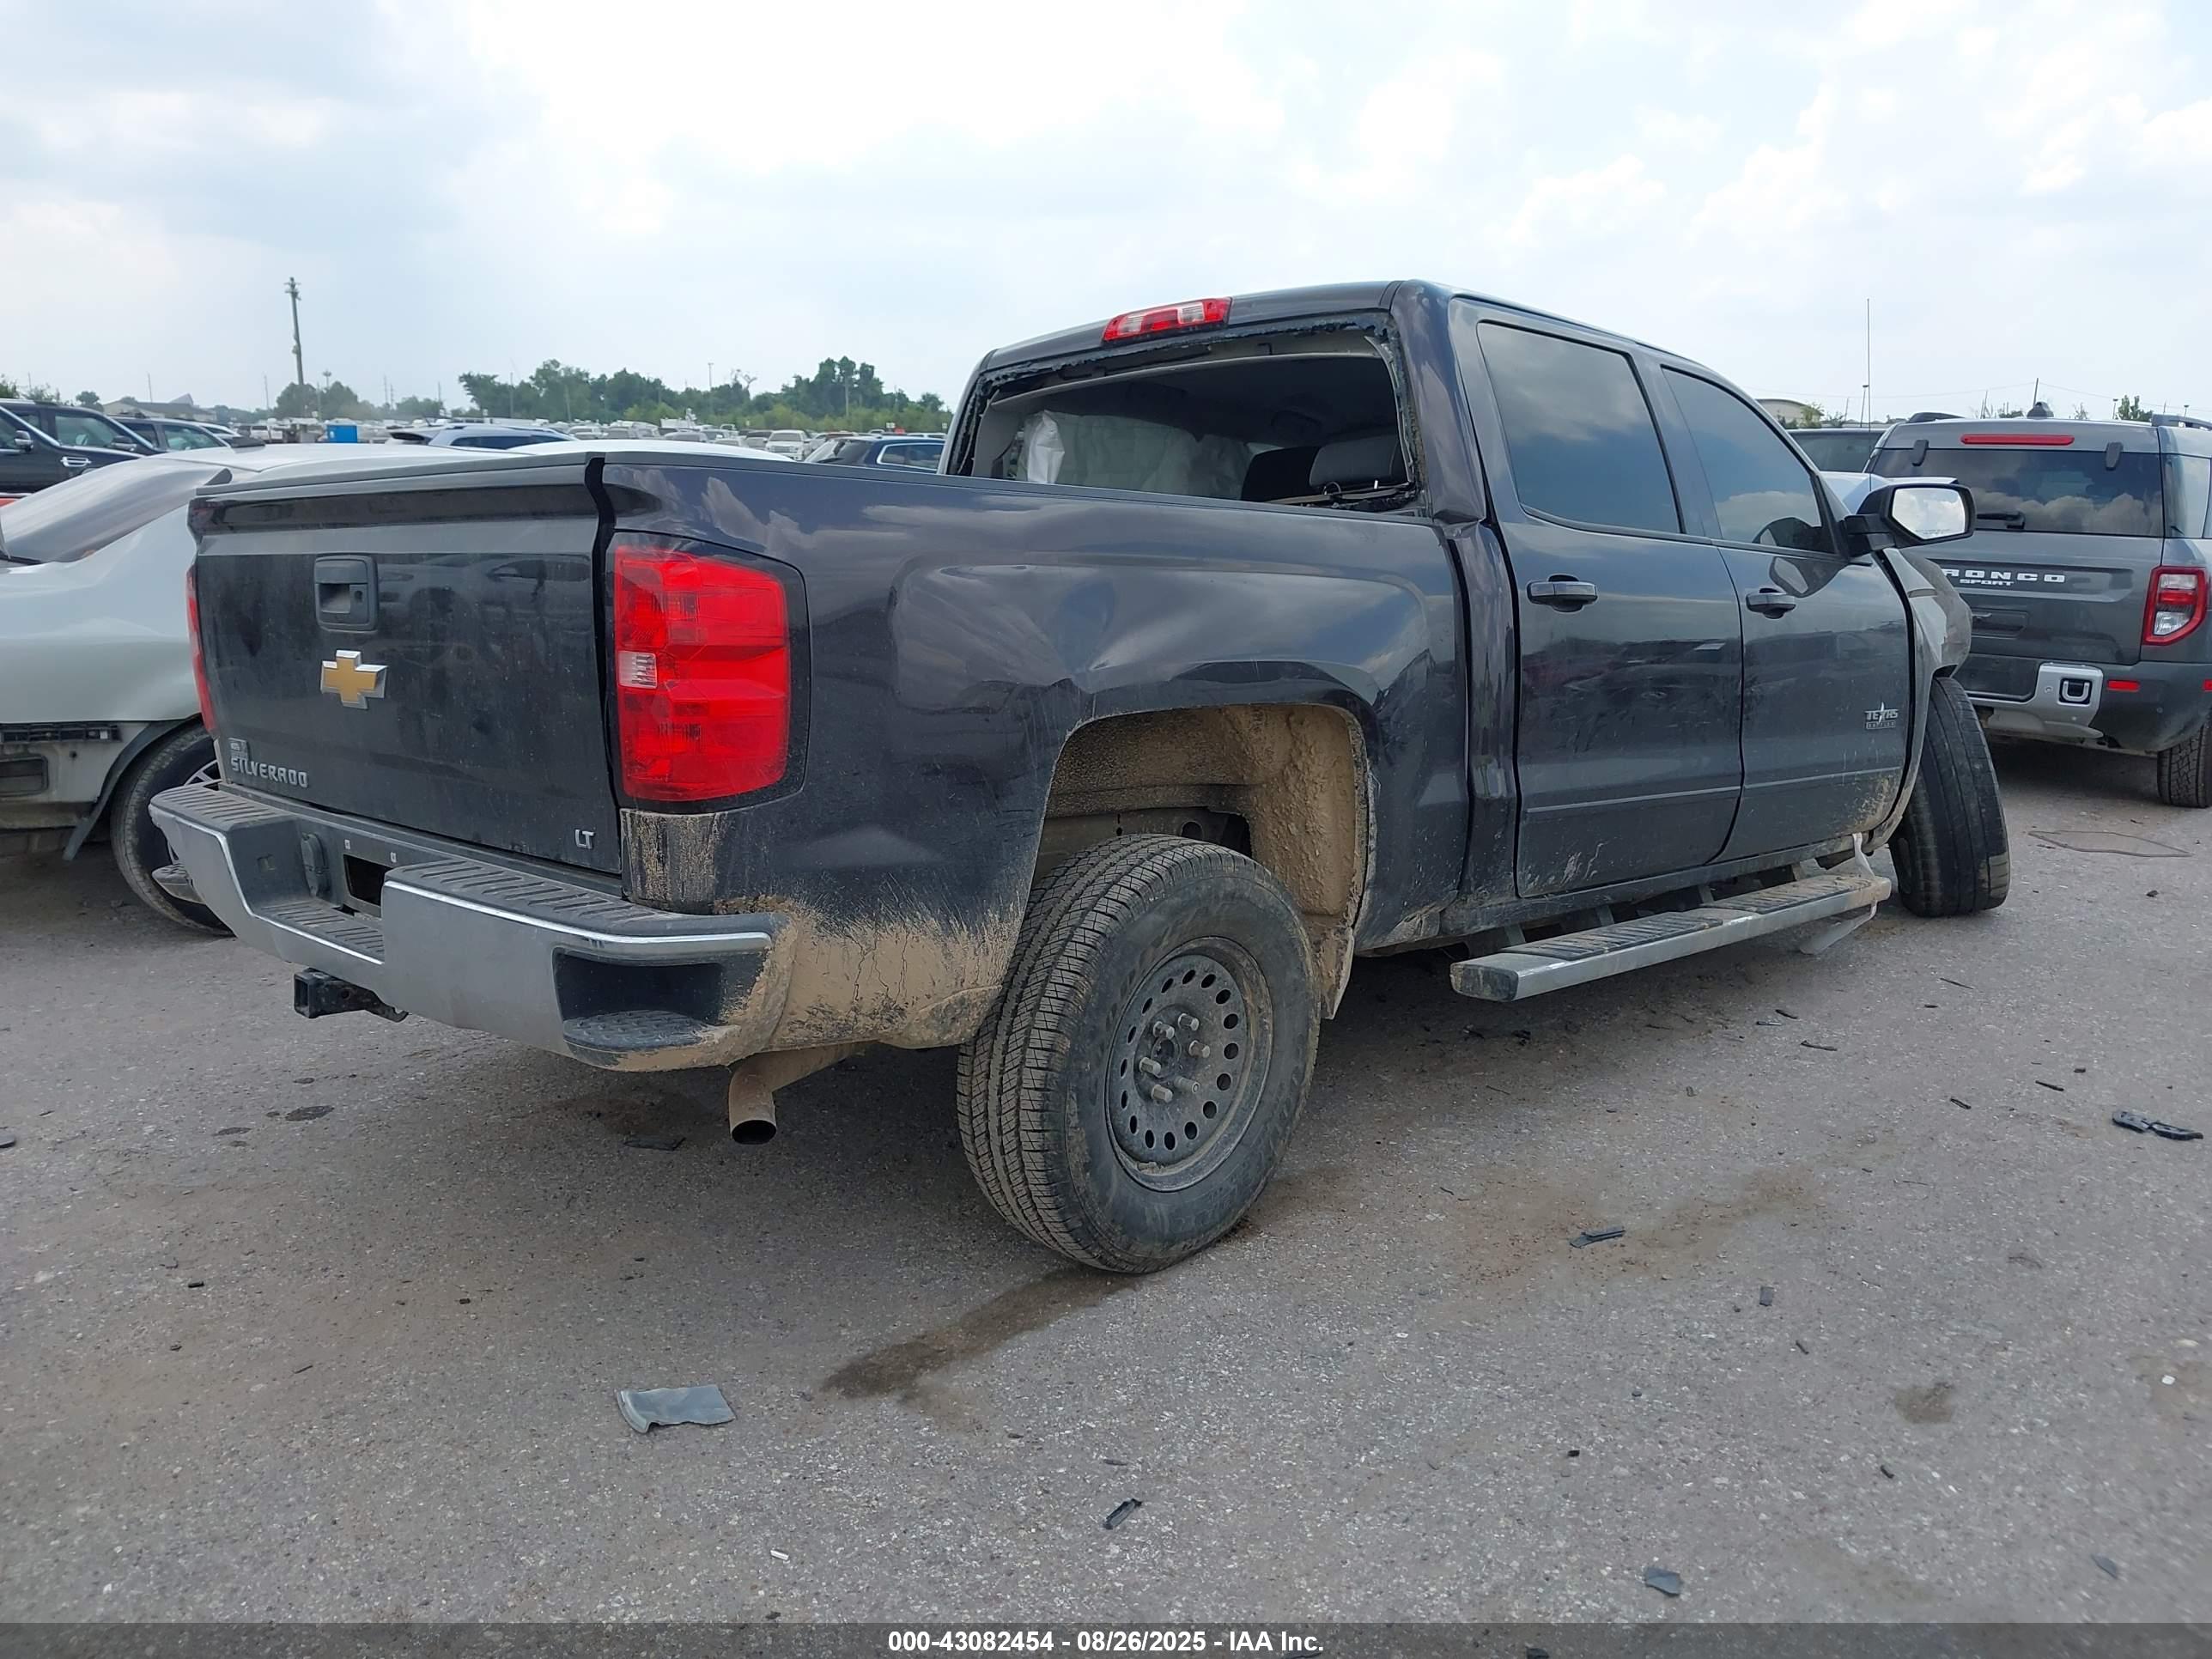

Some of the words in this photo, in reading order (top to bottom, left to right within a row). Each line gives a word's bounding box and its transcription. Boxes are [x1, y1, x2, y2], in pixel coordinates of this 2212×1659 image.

[1940, 568, 2065, 583] RONCO
[230, 757, 308, 788] SILVERADO
[575, 829, 594, 849] LT
